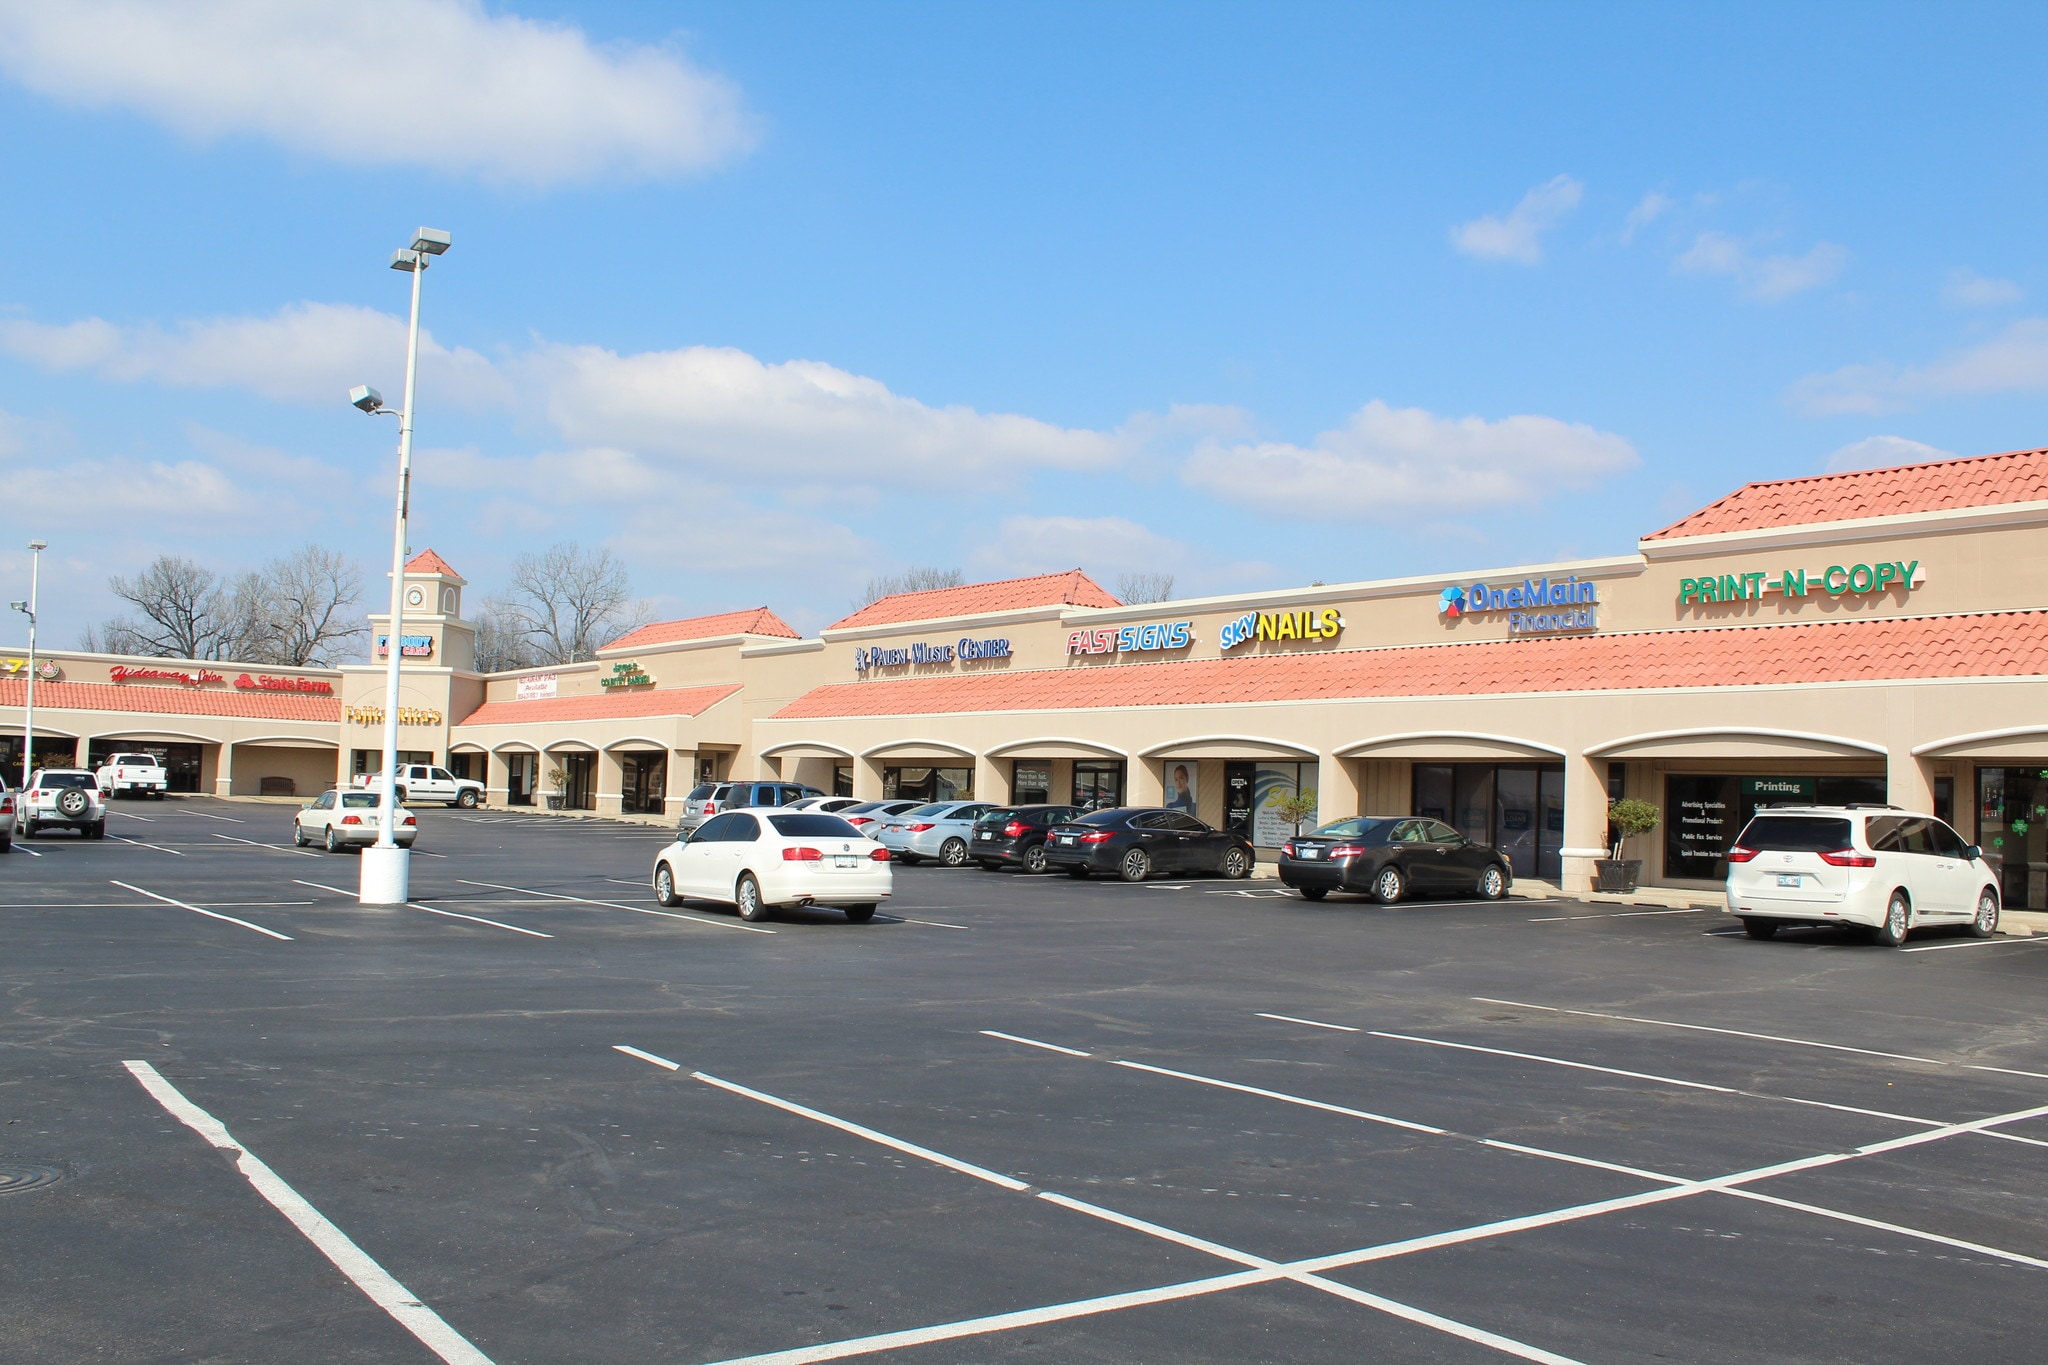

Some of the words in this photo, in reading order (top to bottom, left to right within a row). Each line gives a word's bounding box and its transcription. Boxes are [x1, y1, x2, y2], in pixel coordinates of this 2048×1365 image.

[1469, 576, 1596, 611] OneMain
[1680, 561, 1919, 604] PRINT-N-COPY
[1220, 611, 1256, 648] SKY
[1258, 608, 1340, 642] NAILS
[1509, 607, 1595, 632] Financial
[911, 643, 953, 664] MUSIC
[957, 637, 1010, 659] CENTER
[1065, 621, 1190, 655] FASTSIGNS
[190, 668, 223, 686] Salon
[1755, 781, 1801, 793] Printing
